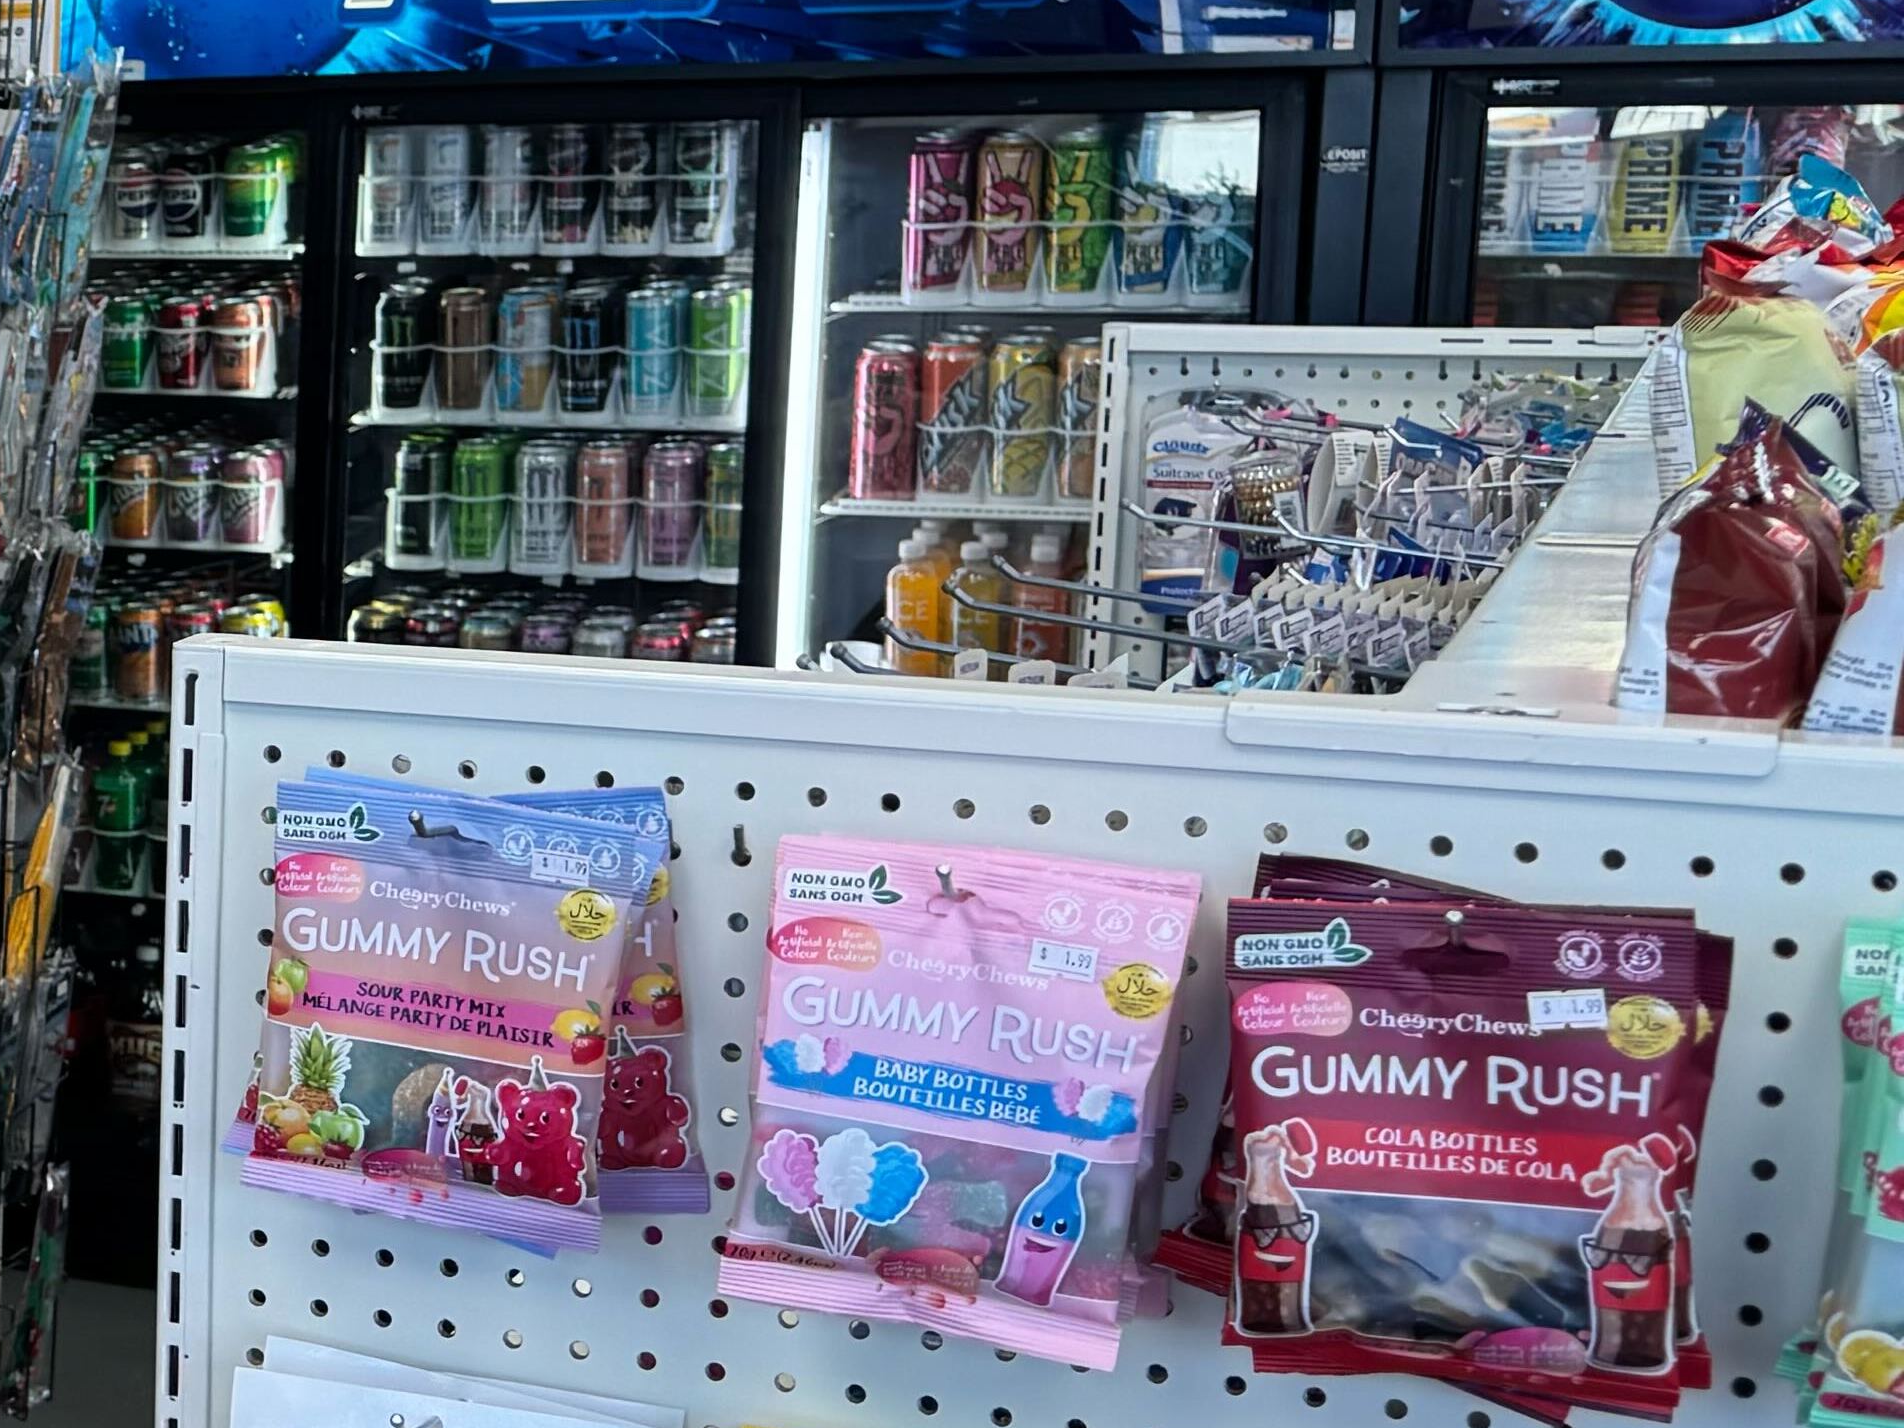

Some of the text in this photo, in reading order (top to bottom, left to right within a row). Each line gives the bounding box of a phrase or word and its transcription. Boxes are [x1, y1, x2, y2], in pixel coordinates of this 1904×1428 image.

[1624, 144, 1670, 234] PRIME
[1152, 466, 1205, 481] Suitcase
[283, 814, 346, 827] NON GMO
[564, 860, 588, 875] 1.99
[792, 873, 865, 889] NON GMO
[370, 881, 511, 917] CheeryChews
[789, 889, 863, 903] SANS OGM
[282, 907, 589, 992] GUMMY RUSH
[1065, 949, 1092, 969] 1.99
[1241, 937, 1324, 951] NON GMO
[1241, 953, 1324, 967] SANS OGM
[888, 949, 1049, 992] CheeryChews
[356, 979, 506, 1019] SOUR PARTY MIX
[1570, 997, 1602, 1015] 1.99
[303, 988, 555, 1049] MÉLANGE PARTY DE PLAISIR
[782, 975, 1137, 1074] GUMMY RUSH
[1359, 1007, 1544, 1039] CheeryChews
[874, 1059, 1028, 1102] BABY BOTTLES
[1251, 1045, 1653, 1117] GUMMY RUSH
[853, 1078, 1041, 1125] BOUTEILLES BÉBÉ
[1365, 1126, 1538, 1157] COLA BOTTLES
[1327, 1146, 1577, 1184] BOUTEILLES DE COLA
